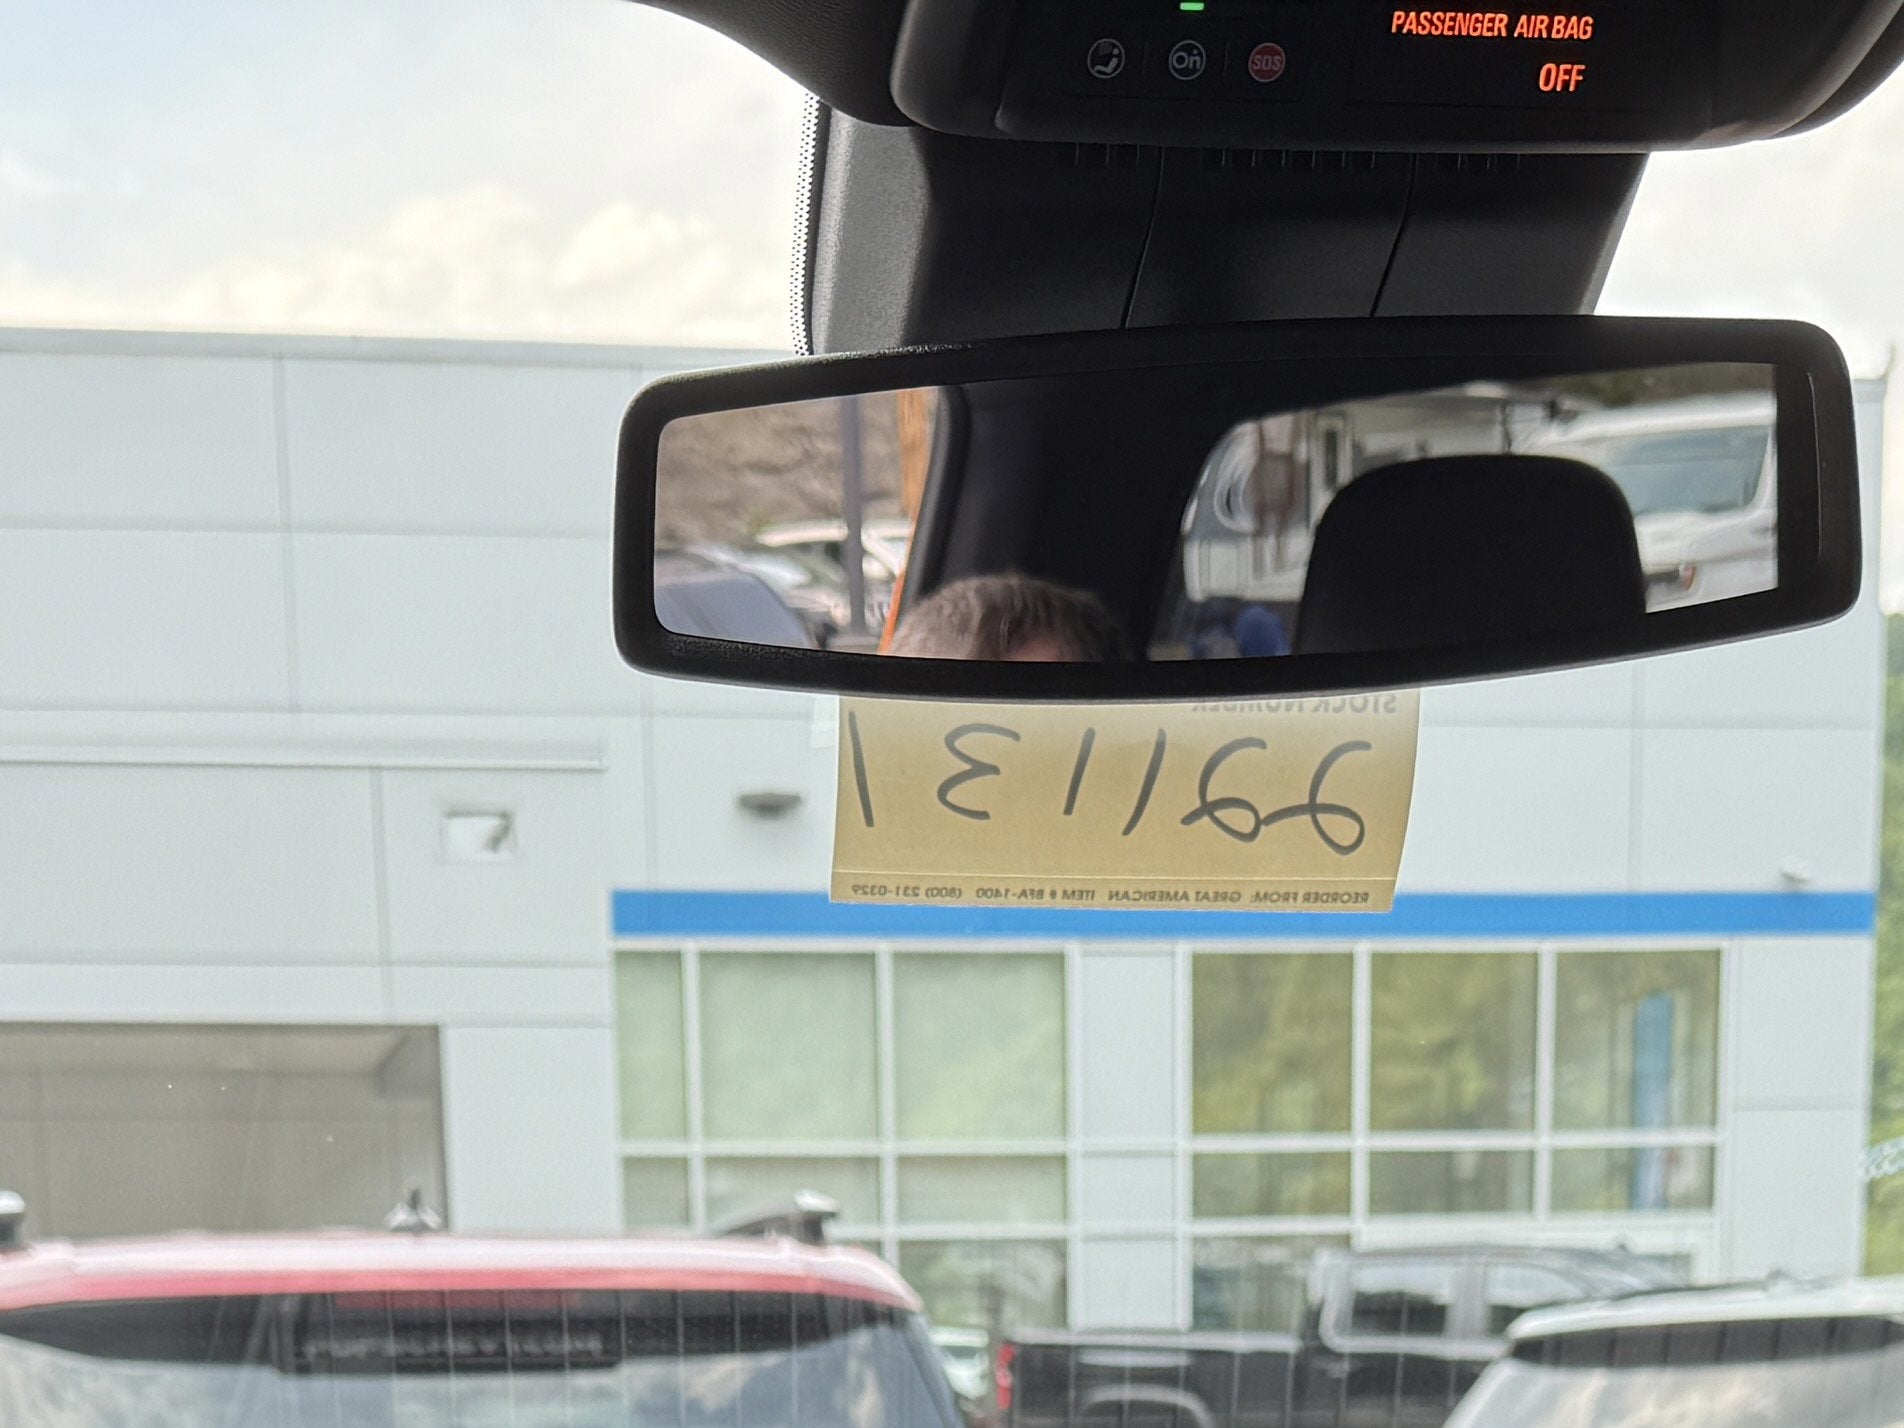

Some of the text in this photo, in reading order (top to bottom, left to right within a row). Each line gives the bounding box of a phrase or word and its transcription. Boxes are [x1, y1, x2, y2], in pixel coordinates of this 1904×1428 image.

[1390, 10, 1593, 41] PASSENGER AIR BAG
[1252, 54, 1283, 72] SOS
[1538, 63, 1585, 92] OFF
